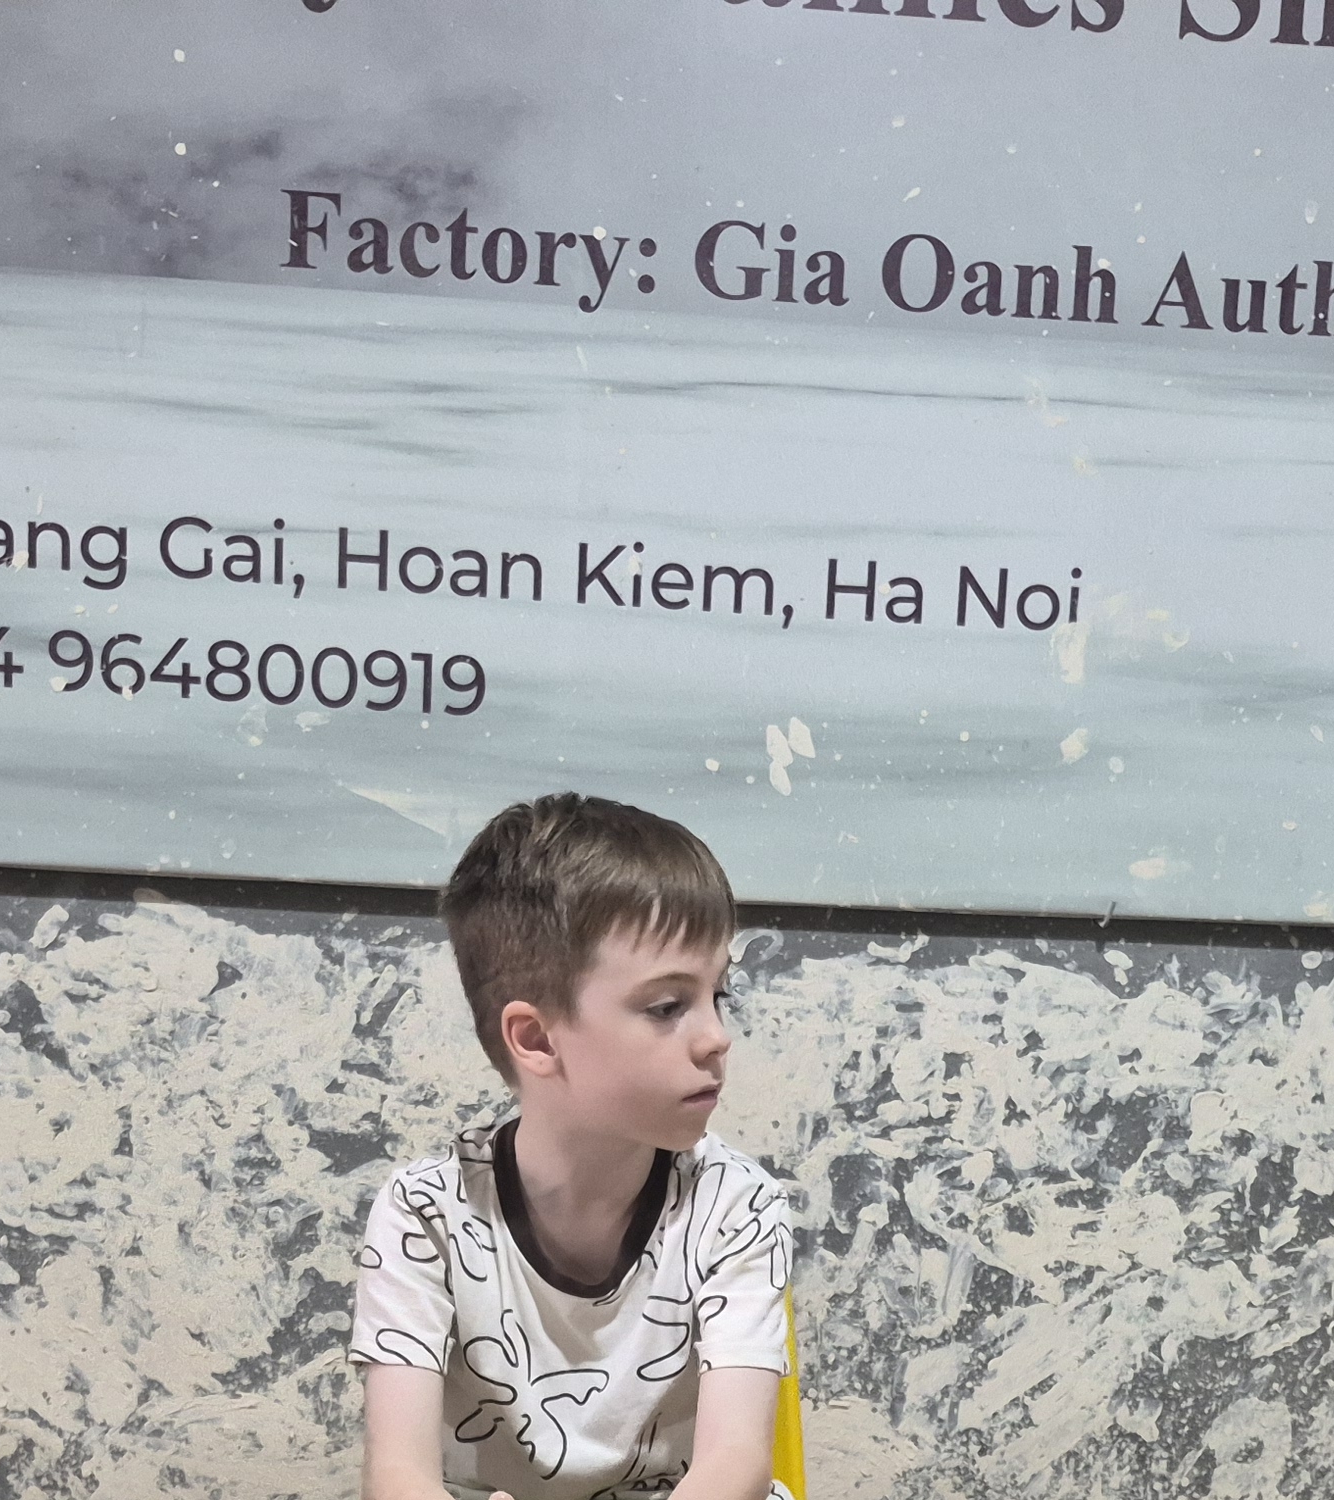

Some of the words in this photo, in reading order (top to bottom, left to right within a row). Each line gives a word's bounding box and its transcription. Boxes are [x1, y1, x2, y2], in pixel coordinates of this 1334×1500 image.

[280, 189, 657, 313] Factory:
[695, 220, 851, 307] Gia
[881, 233, 1116, 325] Oanh
[159, 516, 307, 602] Gai,
[337, 526, 544, 602] Hoan
[576, 541, 797, 630] Kiem,
[825, 558, 925, 625] Ha
[956, 565, 1081, 632] Noi
[38, 629, 488, 718] 964800919
